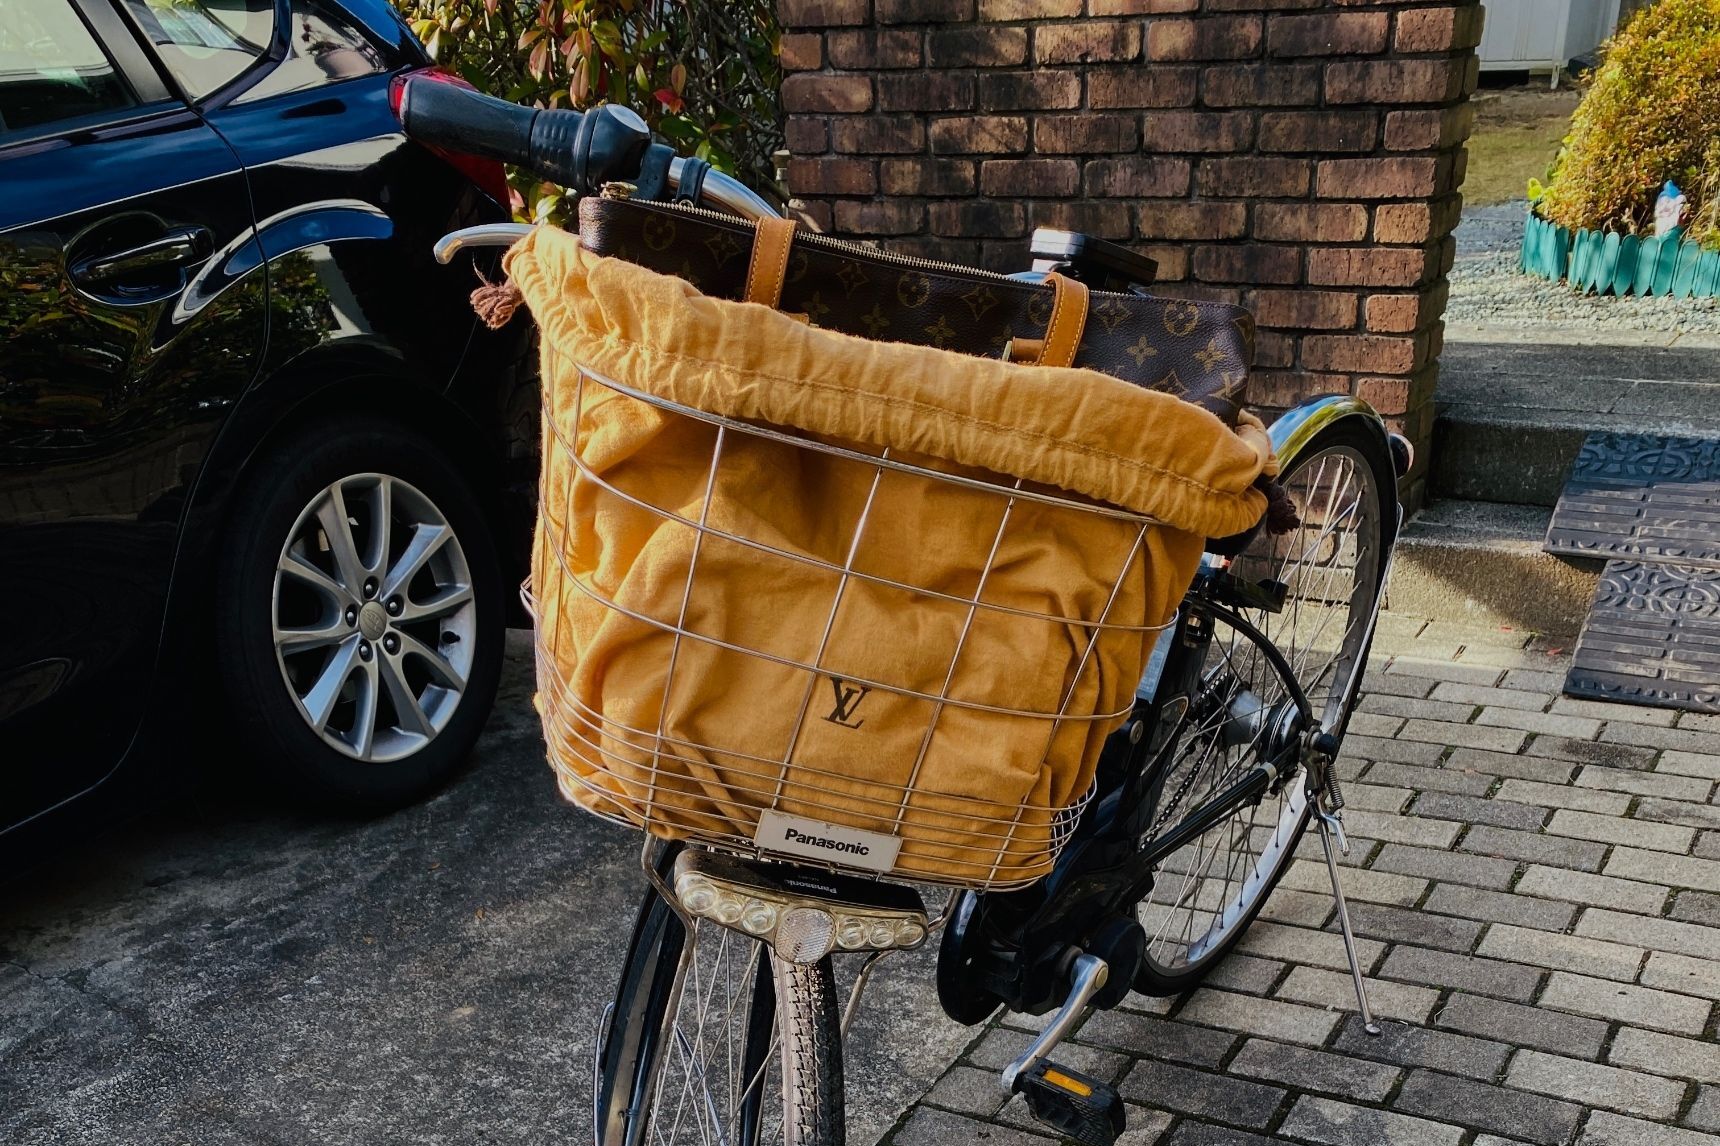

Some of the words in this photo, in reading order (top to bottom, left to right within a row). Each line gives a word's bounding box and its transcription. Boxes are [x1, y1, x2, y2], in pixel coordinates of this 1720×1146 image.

[821, 676, 872, 729] LV
[785, 828, 869, 855] Panasonic
[784, 879, 837, 894] Panasonic
